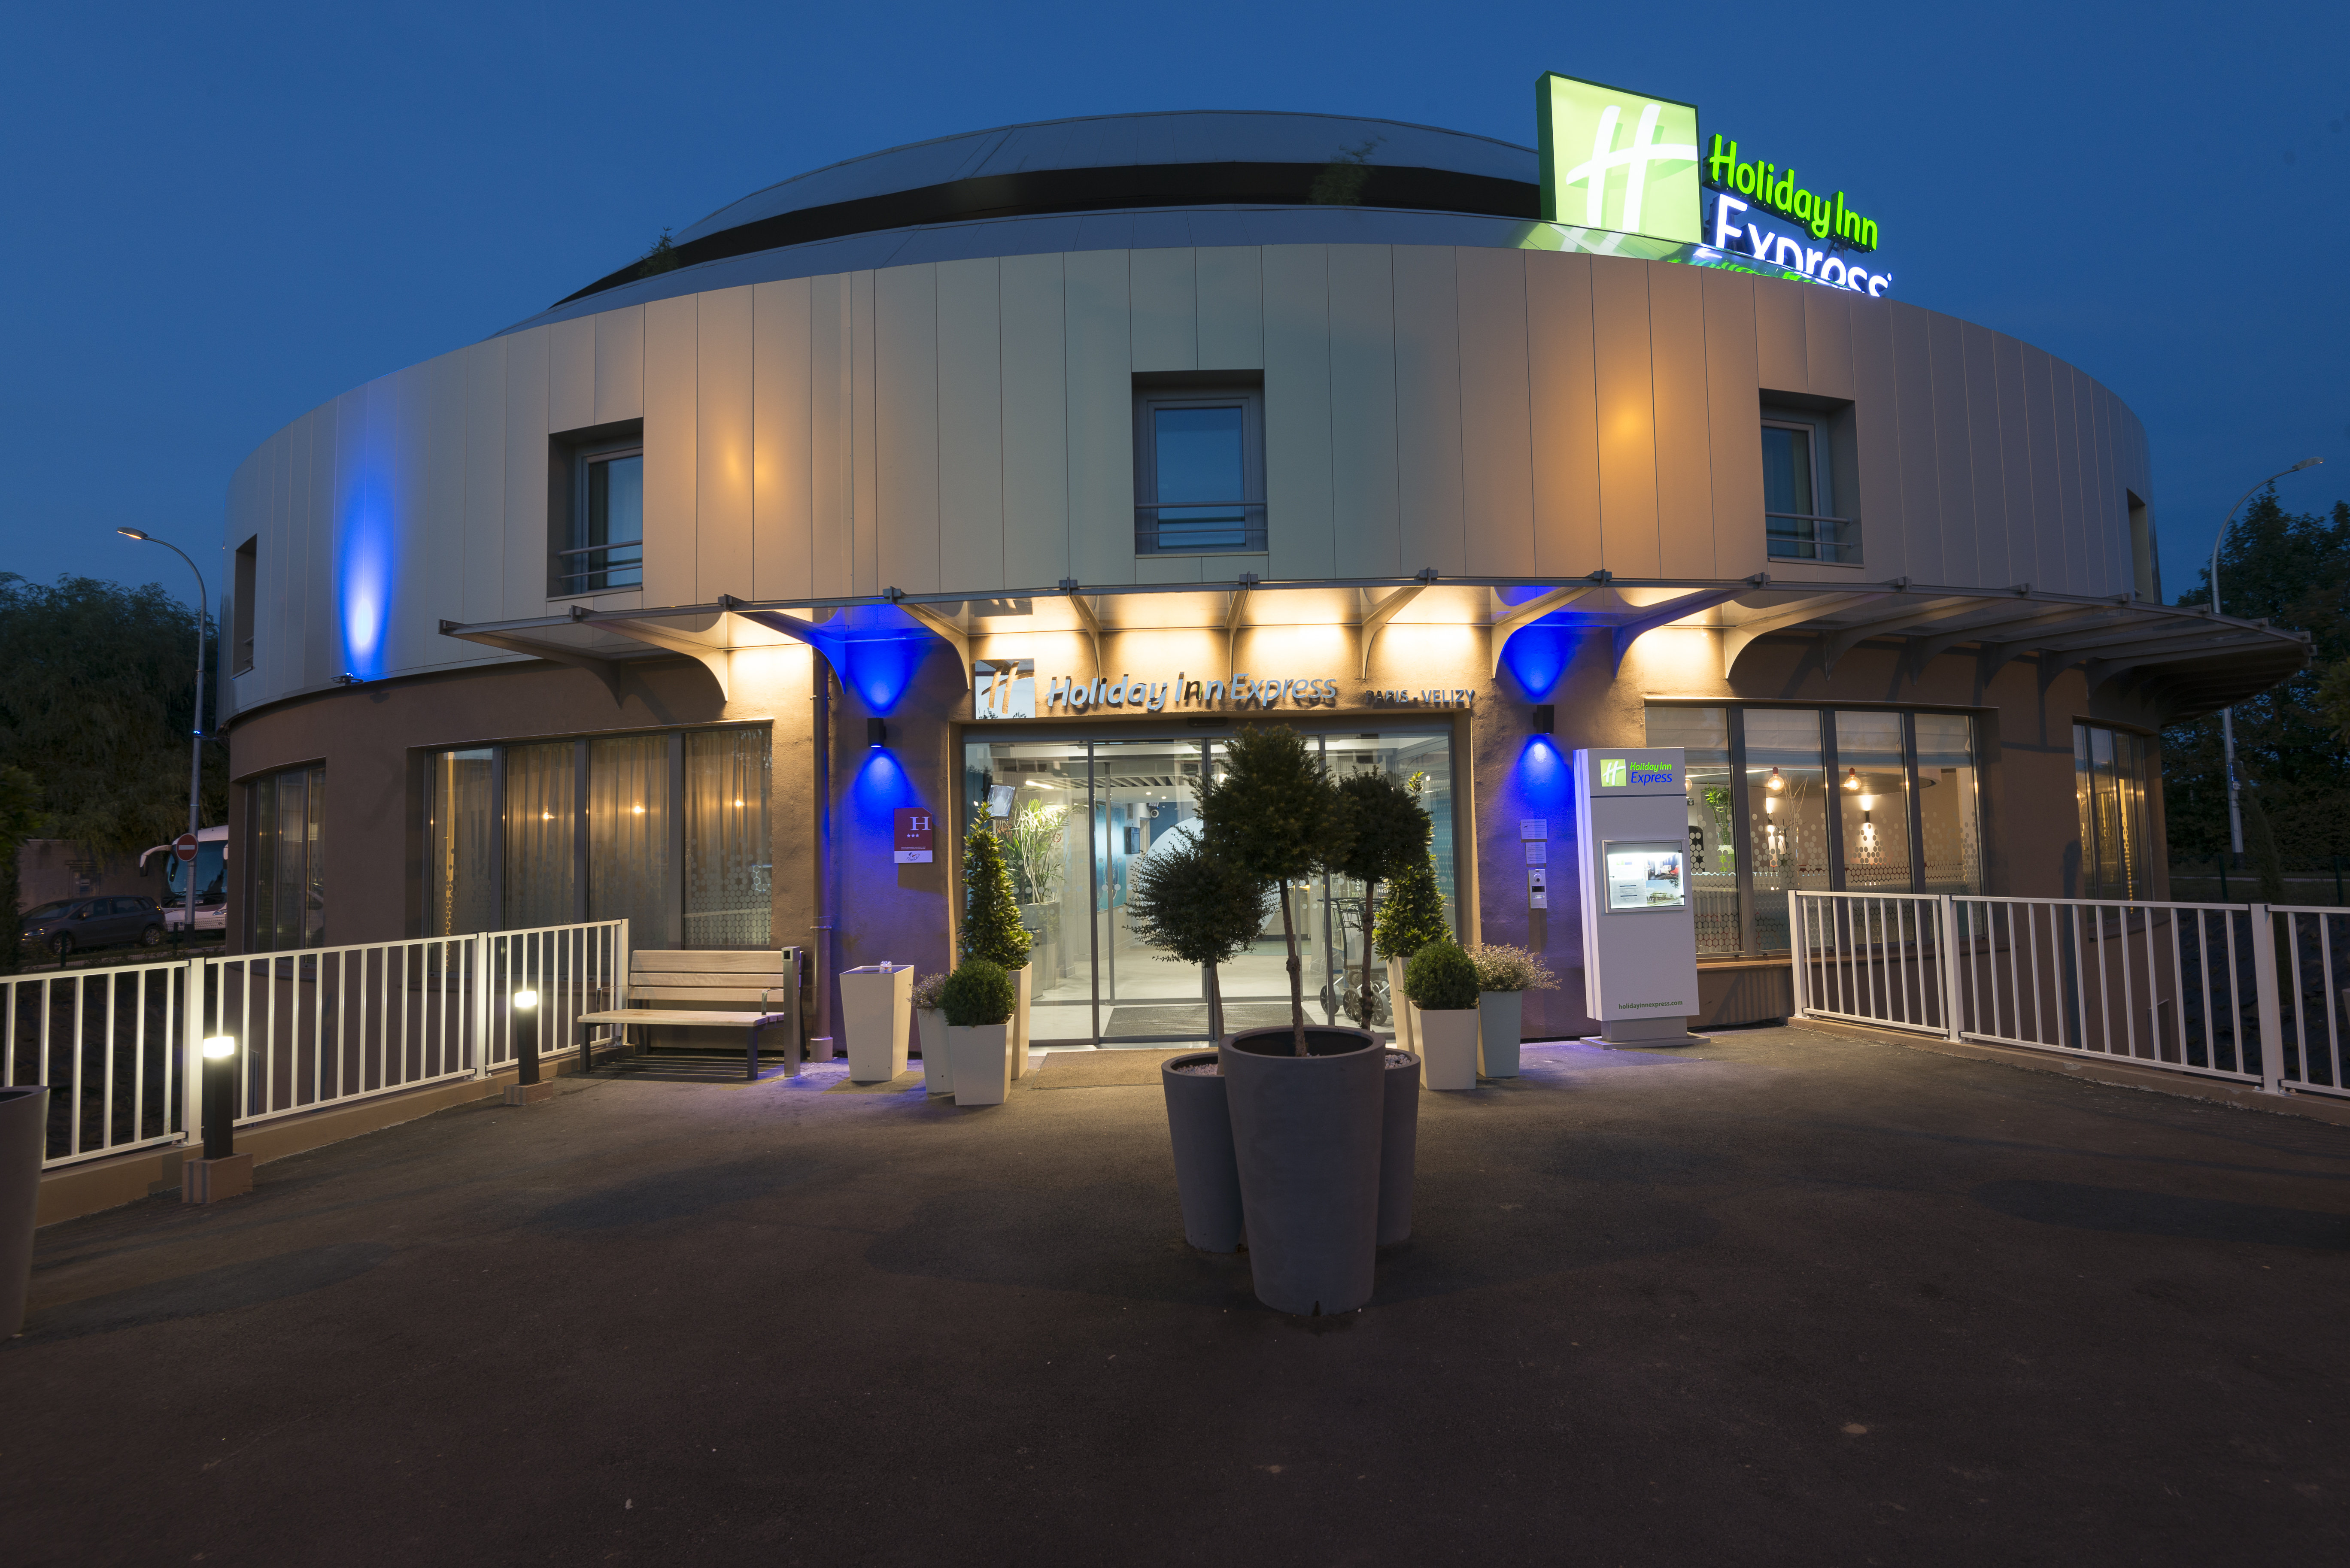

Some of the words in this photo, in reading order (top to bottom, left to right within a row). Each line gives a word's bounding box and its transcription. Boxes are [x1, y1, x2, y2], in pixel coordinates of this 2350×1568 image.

[1709, 133, 1831, 238] Holiday
[1835, 190, 1878, 250] Inn
[1045, 673, 1168, 710] Holiday
[1175, 671, 1226, 701] Inn
[1230, 673, 1337, 707] Express
[1366, 690, 1409, 703] PARIS
[1421, 689, 1475, 703] VELIZY
[1630, 762, 1659, 772] Holiday
[1660, 761, 1672, 770] Inn
[1631, 772, 1673, 786] Express
[910, 816, 931, 831] H
[1618, 1001, 1683, 1010] holidayinnexpress.com
